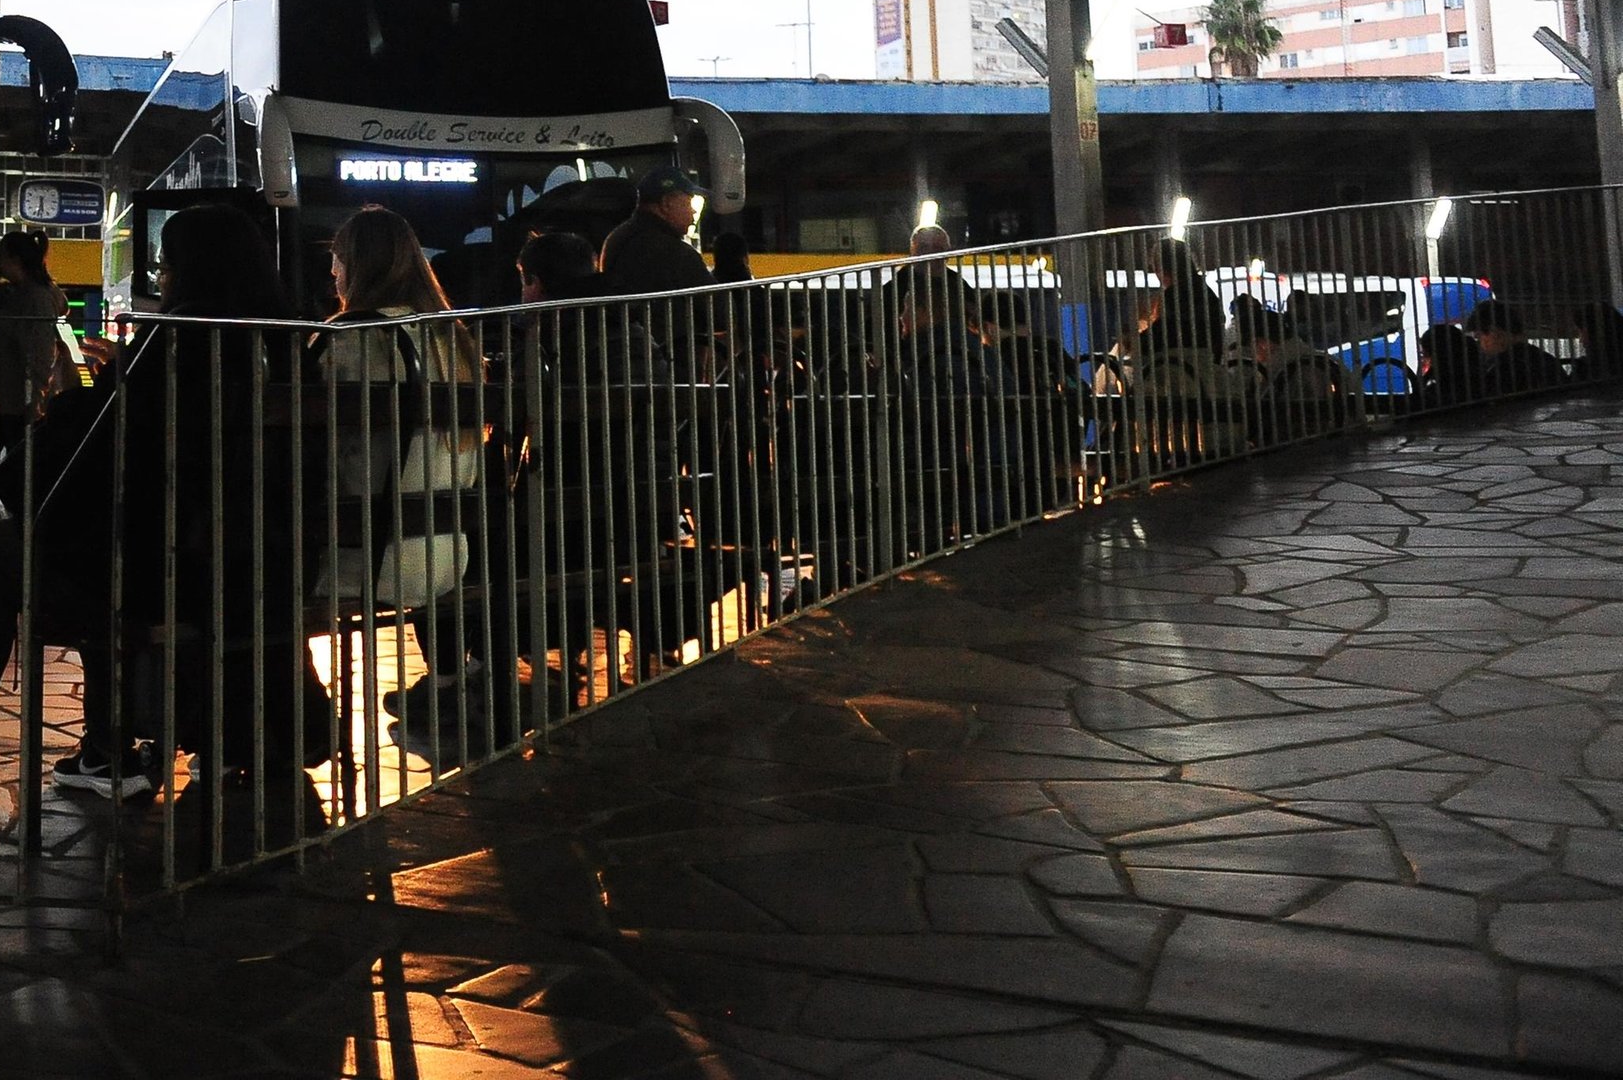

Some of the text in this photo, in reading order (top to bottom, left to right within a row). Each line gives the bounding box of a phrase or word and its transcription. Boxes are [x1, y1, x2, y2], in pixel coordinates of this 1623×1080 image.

[361, 119, 615, 148] Double Service & Leito
[340, 160, 402, 181] PORTO
